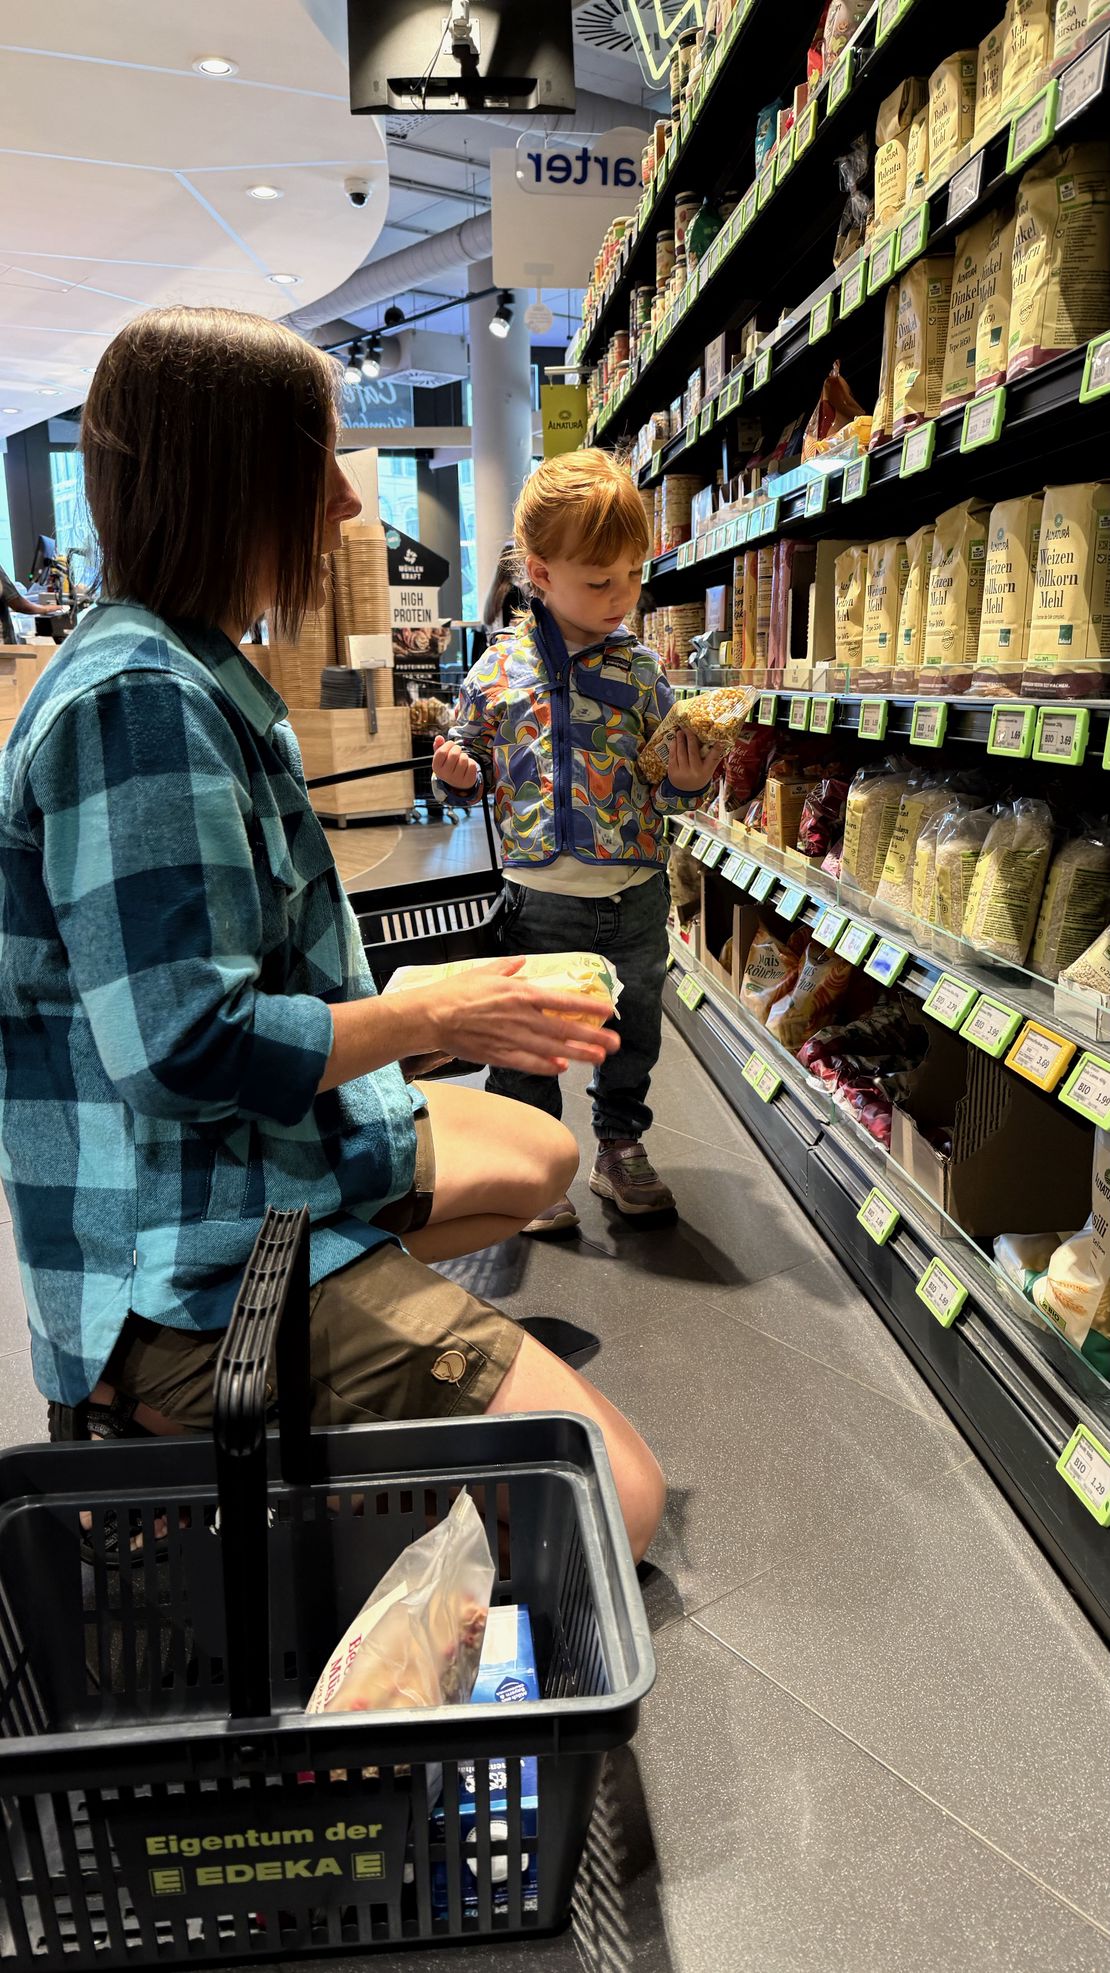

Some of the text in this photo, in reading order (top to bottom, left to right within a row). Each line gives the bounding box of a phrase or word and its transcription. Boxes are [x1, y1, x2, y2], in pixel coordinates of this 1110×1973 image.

[878, 162, 902, 183] Polenta
[951, 280, 980, 310] Dinkel
[951, 303, 975, 328] Mehl
[548, 419, 584, 430] ALNATURA
[1045, 525, 1071, 541] ALNATURA
[1040, 549, 1075, 567] Weizen
[985, 578, 1017, 596] ollkorn
[401, 592, 424, 606] HIGH
[867, 598, 883, 613] Mehl
[930, 591, 948, 607] Mehl
[985, 597, 1004, 615] Mehl
[1039, 590, 1065, 609] Mehl
[394, 608, 432, 623] PROTEIN
[1036, 1056, 1050, 1069] 3.69
[1077, 1082, 1110, 1107] BIO 1.99
[1092, 1212, 1110, 1239] silli
[1073, 1457, 1106, 1496] BIO 1.29
[146, 1822, 383, 1856] Eigentum der
[196, 1857, 343, 1886] EDEKA
